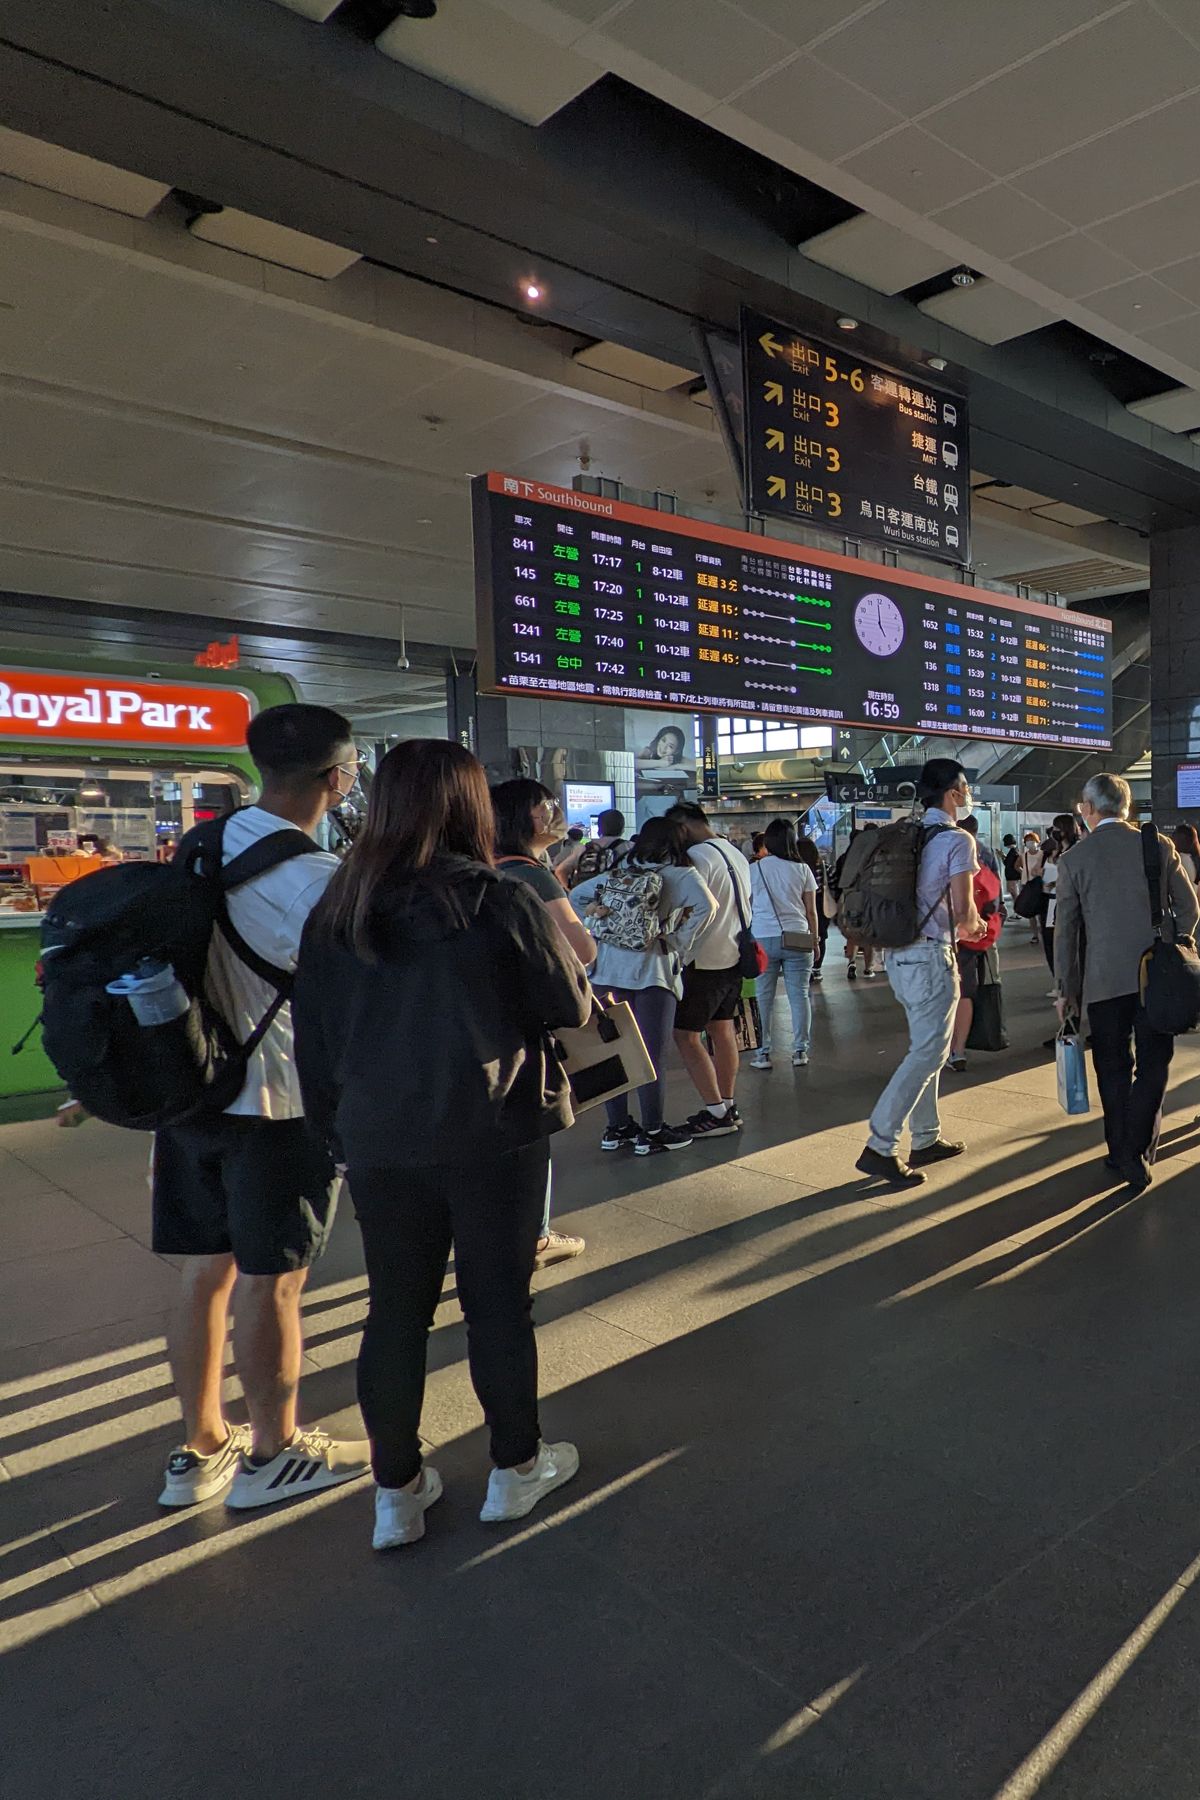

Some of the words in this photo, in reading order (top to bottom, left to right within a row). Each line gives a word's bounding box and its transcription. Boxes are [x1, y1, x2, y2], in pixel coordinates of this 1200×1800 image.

[792, 341, 819, 367] 出口
[825, 356, 865, 393] 5-6
[792, 361, 809, 376] Exit
[793, 388, 820, 413] 出口
[825, 401, 840, 427] 3
[793, 407, 810, 422] Exit
[898, 403, 912, 416] Bus
[913, 409, 938, 425] station
[794, 434, 822, 458] 出口
[826, 447, 840, 472] 3
[911, 430, 937, 454] 捷運
[794, 454, 811, 469] Exit
[922, 453, 937, 466] MRT
[913, 473, 938, 496] 台鐵
[503, 477, 534, 497] 南下
[537, 487, 613, 515] Southbound
[796, 481, 823, 504] 出口
[827, 492, 842, 517] 3
[796, 500, 813, 514] Exit
[925, 495, 939, 507] TRA
[883, 525, 900, 537] Wuri
[901, 529, 915, 541] bus
[915, 534, 940, 548] station
[512, 537, 534, 551] 841
[552, 544, 579, 561] 左營
[592, 553, 622, 568] 17:17
[635, 562, 641, 573] 1
[720, 579, 727, 589] 3
[514, 566, 536, 580] 145
[553, 572, 580, 588] 左營
[593, 581, 623, 595] 17:20
[636, 588, 642, 599] 1
[721, 604, 733, 615] 15
[515, 595, 535, 608] 661
[554, 600, 580, 616] 左營
[594, 607, 623, 621] 17:25
[637, 614, 643, 625] 1
[721, 629, 732, 639] 11
[922, 619, 938, 630] 1652
[967, 628, 984, 639] 15:32
[990, 633, 996, 641] 2
[512, 623, 540, 636] 1241
[555, 627, 581, 643] 左營
[594, 635, 624, 648] 17:40
[638, 641, 643, 651] 1
[721, 653, 734, 664] 45
[924, 640, 936, 650] 834
[967, 648, 984, 659] 15:36
[991, 653, 996, 661] 2
[513, 651, 541, 664] 1541
[556, 655, 582, 669] 台中
[595, 661, 625, 675] 17:42
[638, 667, 644, 677] 1
[925, 661, 938, 671] 136
[967, 668, 985, 679] 15:39
[991, 672, 996, 680] 2
[923, 682, 939, 692] 1318
[967, 688, 985, 698] 15:53
[991, 692, 996, 700] 2
[106, 690, 212, 731] Park
[862, 701, 900, 719] 16:59
[925, 703, 938, 712] 654
[968, 708, 985, 718] 16:00
[991, 711, 996, 720] 2
[840, 731, 851, 739] 1-6
[853, 786, 874, 800] 1-6
